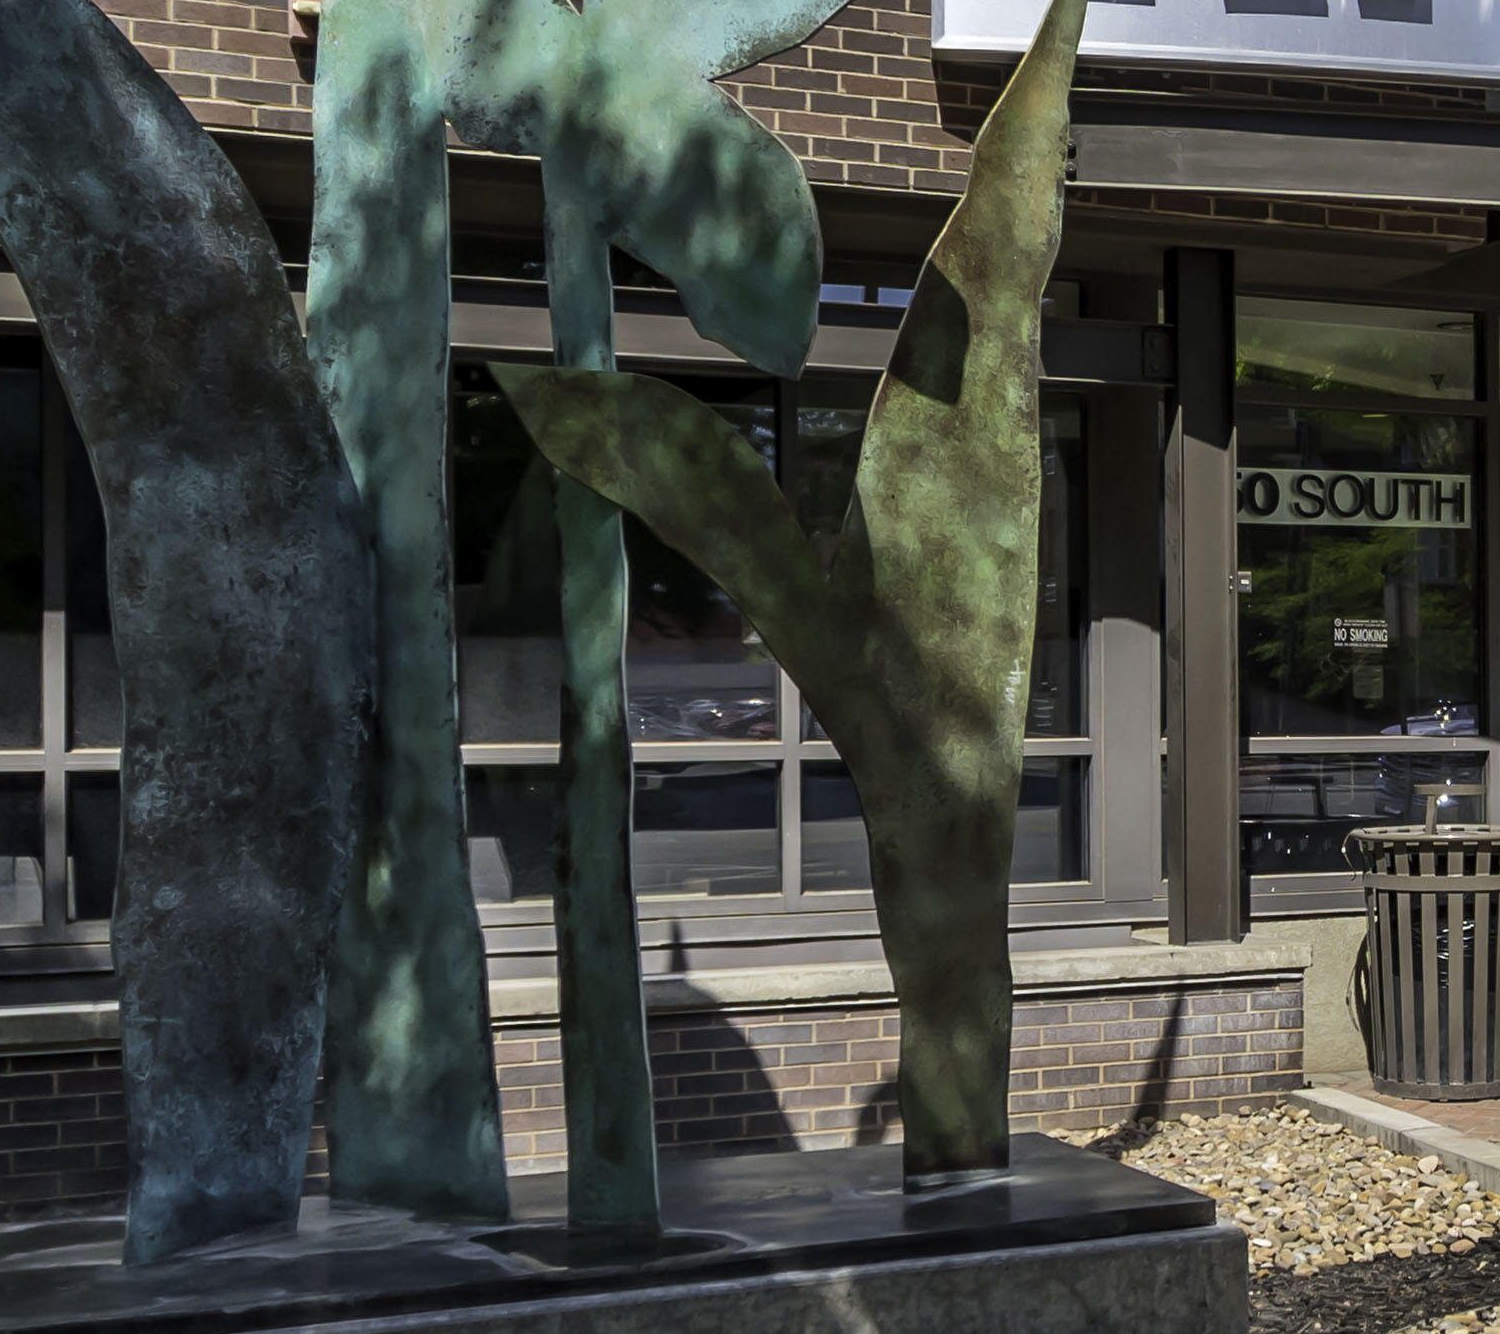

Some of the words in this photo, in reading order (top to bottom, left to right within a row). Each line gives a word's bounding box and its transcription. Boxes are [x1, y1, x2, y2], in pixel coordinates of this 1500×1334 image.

[1237, 471, 1280, 517] 0
[1293, 474, 1466, 524] SOUTH
[1334, 628, 1347, 641] NO
[1350, 628, 1388, 642] SMOKING
